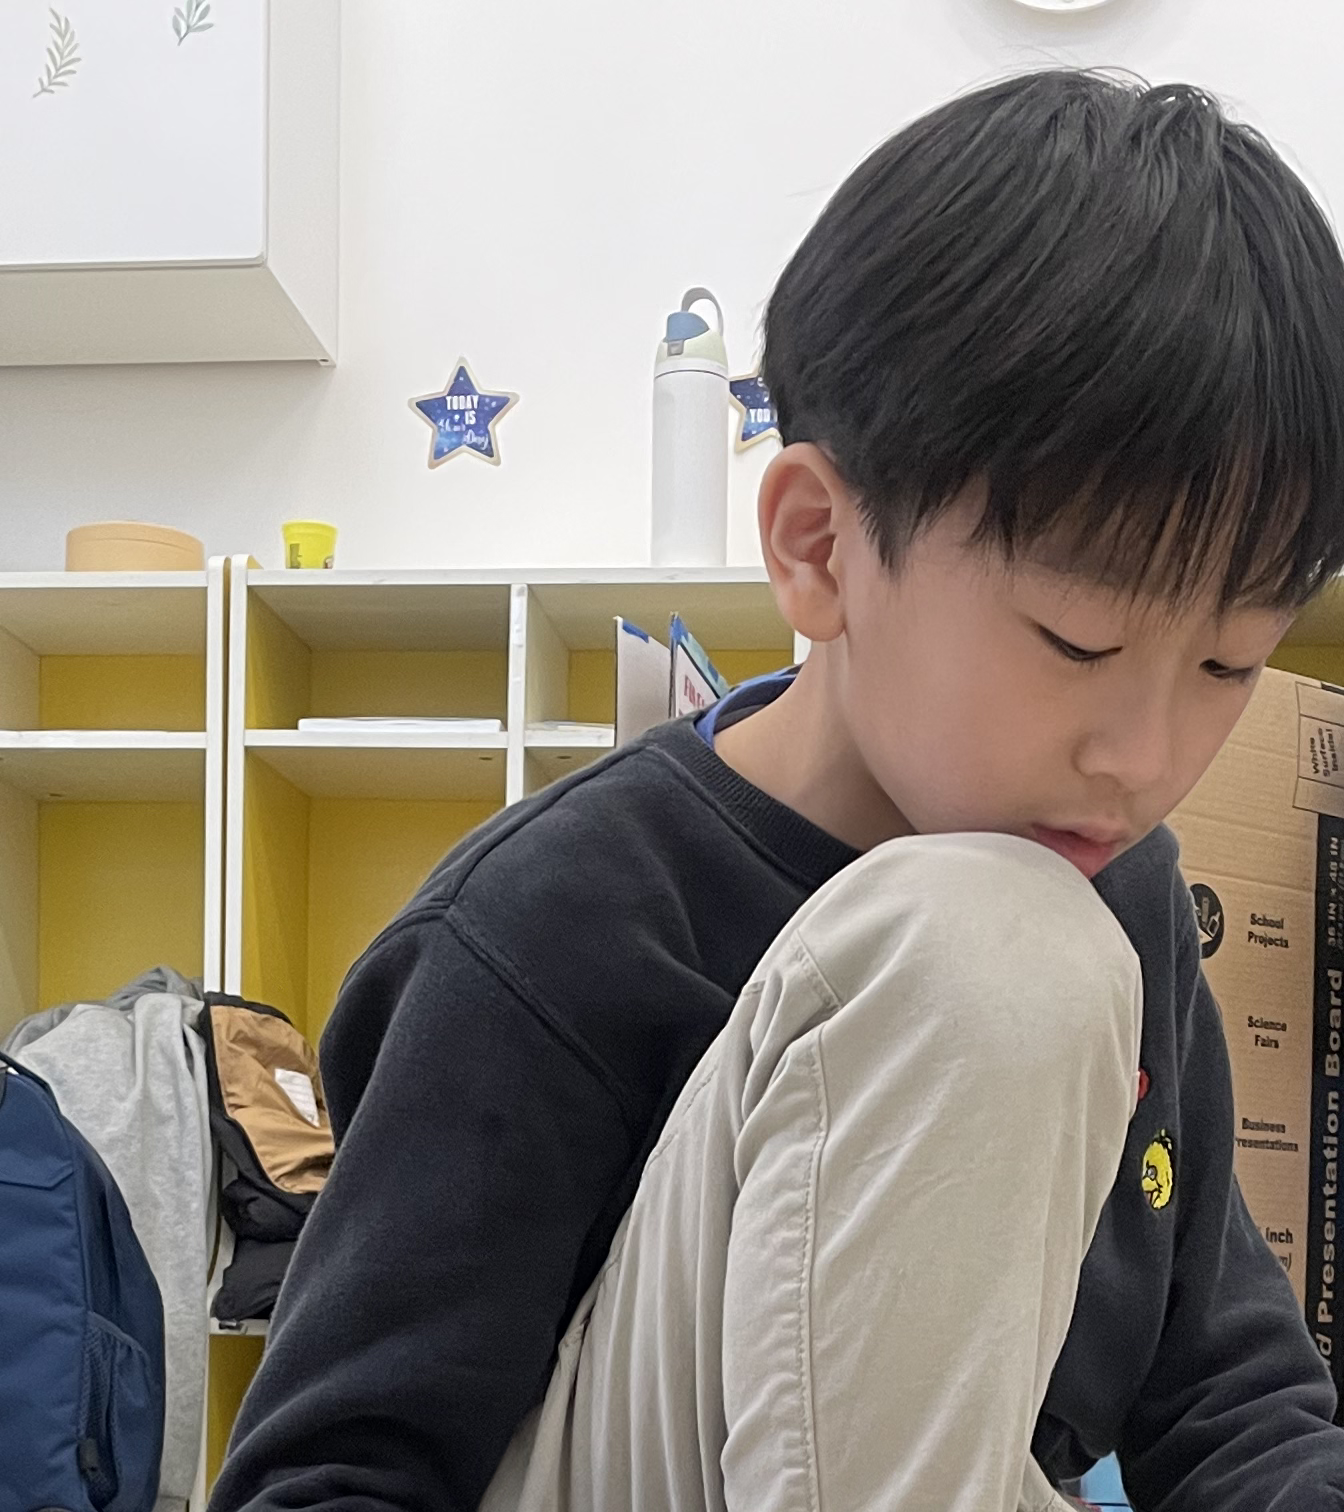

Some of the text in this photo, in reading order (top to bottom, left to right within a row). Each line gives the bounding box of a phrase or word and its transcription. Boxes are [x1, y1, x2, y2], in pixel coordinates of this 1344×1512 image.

[445, 394, 479, 410] TODAY
[464, 410, 477, 425] IS
[1250, 913, 1285, 930] School
[1247, 931, 1289, 949] Projects
[1247, 1015, 1287, 1033] Science
[1325, 968, 1343, 1077] Board
[1254, 1034, 1280, 1049] Fairs
[1241, 1117, 1286, 1134] Business
[1317, 1091, 1339, 1323] Presentation
